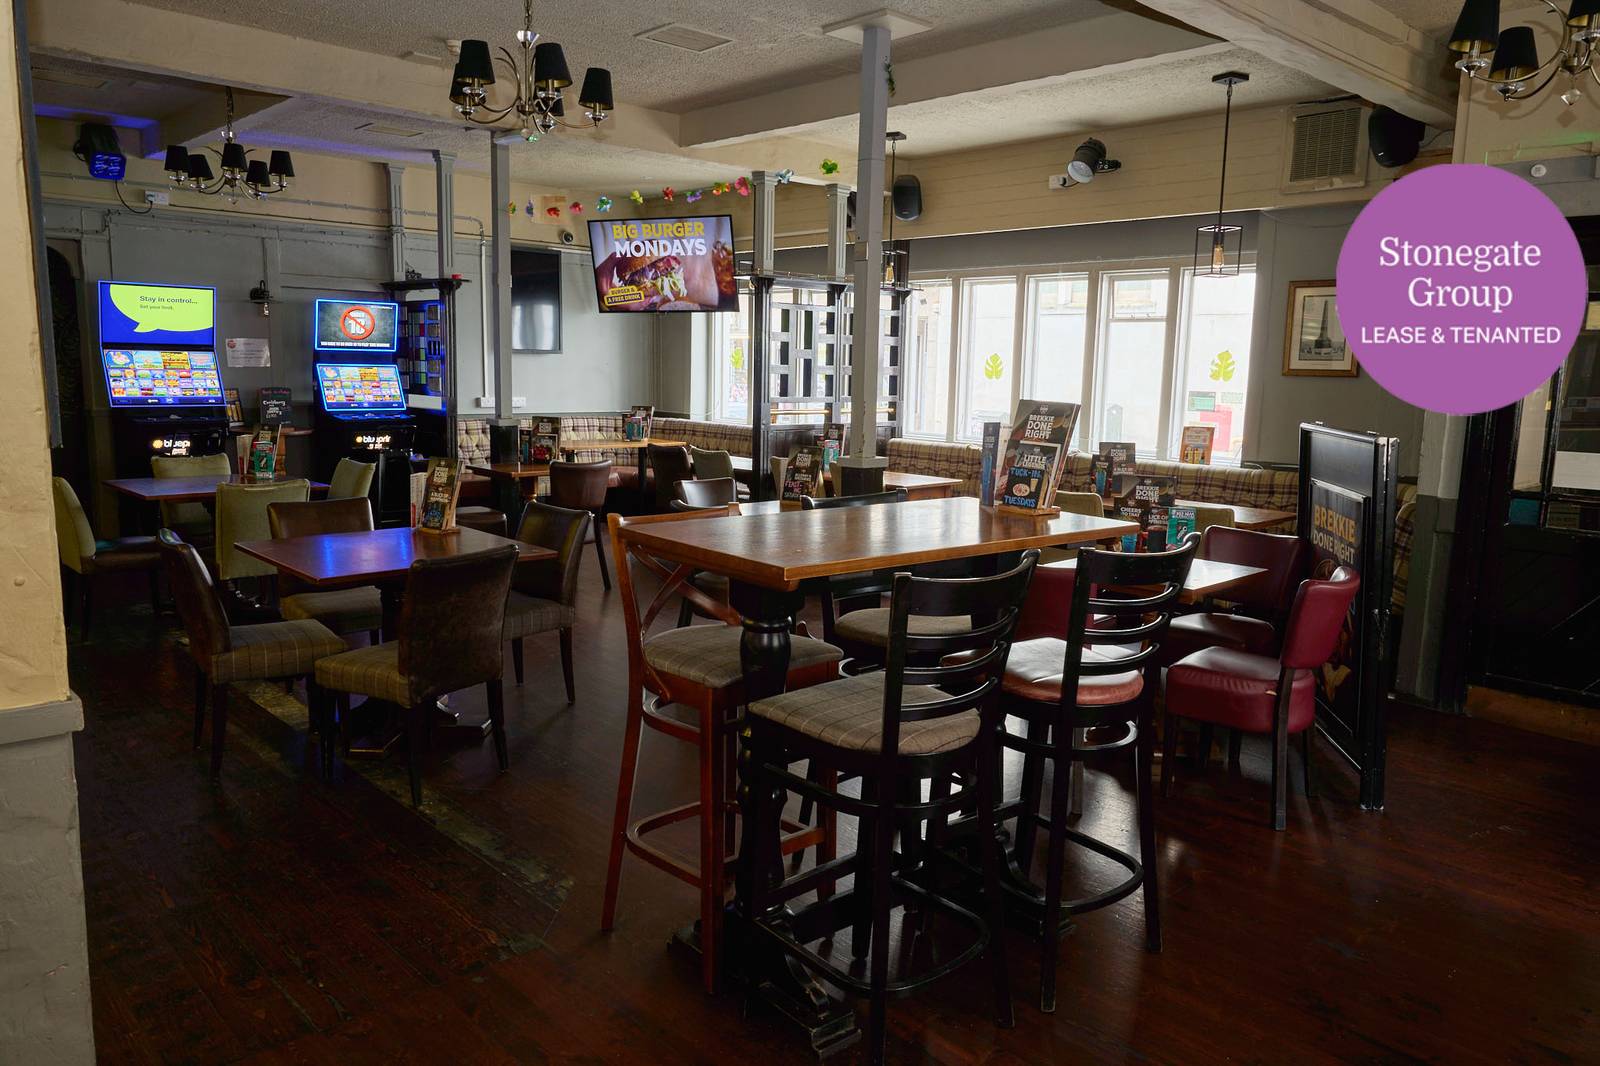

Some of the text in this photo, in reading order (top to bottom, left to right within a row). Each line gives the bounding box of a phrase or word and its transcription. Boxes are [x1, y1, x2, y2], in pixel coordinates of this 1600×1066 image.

[612, 221, 705, 240] BIG BURGER
[614, 238, 707, 258] MONDAYS
[139, 295, 156, 303] Stay
[1027, 421, 1054, 431] DONE
[1024, 430, 1052, 439] RIGHT
[1023, 454, 1047, 464] LITTLE
[1135, 490, 1160, 498] DONE
[1003, 495, 1037, 507] TUESDAYS
[1314, 504, 1356, 543] BREKKIE
[1312, 530, 1356, 565] DONE RIGHT
